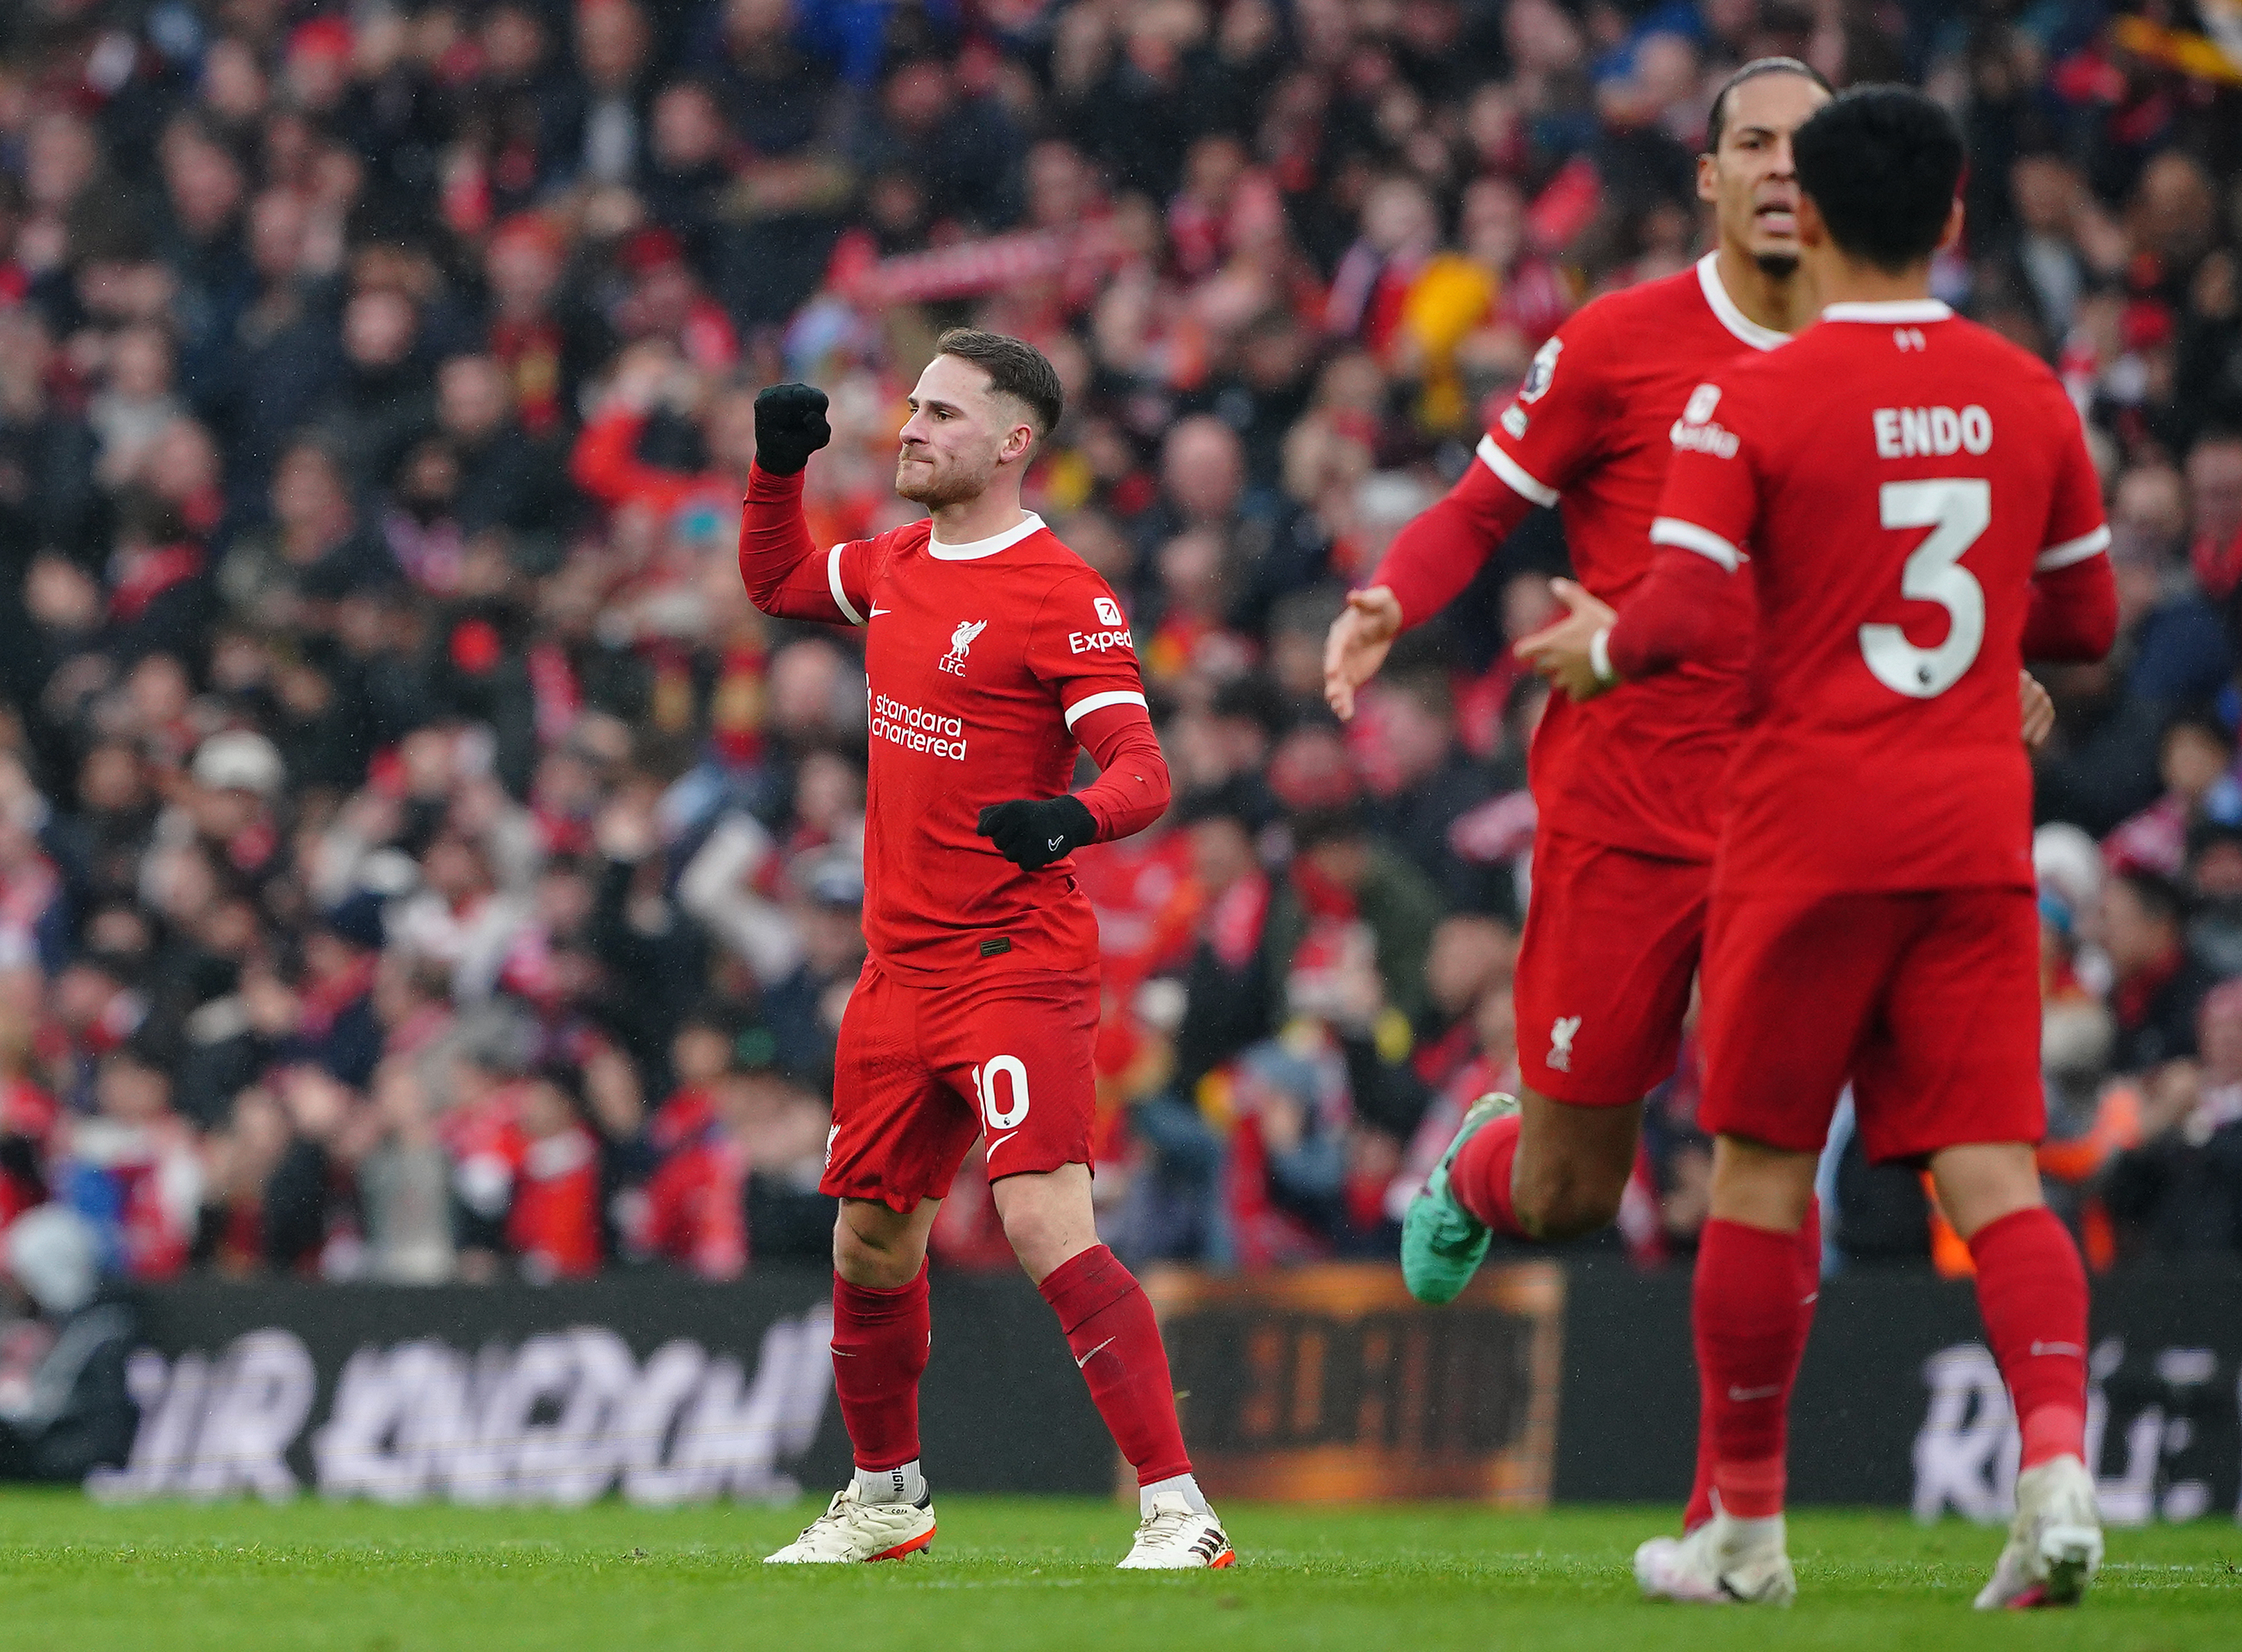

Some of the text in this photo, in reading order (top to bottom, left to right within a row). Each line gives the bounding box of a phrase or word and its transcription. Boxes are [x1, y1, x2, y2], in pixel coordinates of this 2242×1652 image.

[1873, 404, 1993, 458] ENDO
[1858, 477, 1992, 698] 3
[1068, 628, 1133, 654] Exped
[875, 694, 961, 737] standard
[872, 716, 966, 761] chartered
[891, 1466, 905, 1492] IGN
